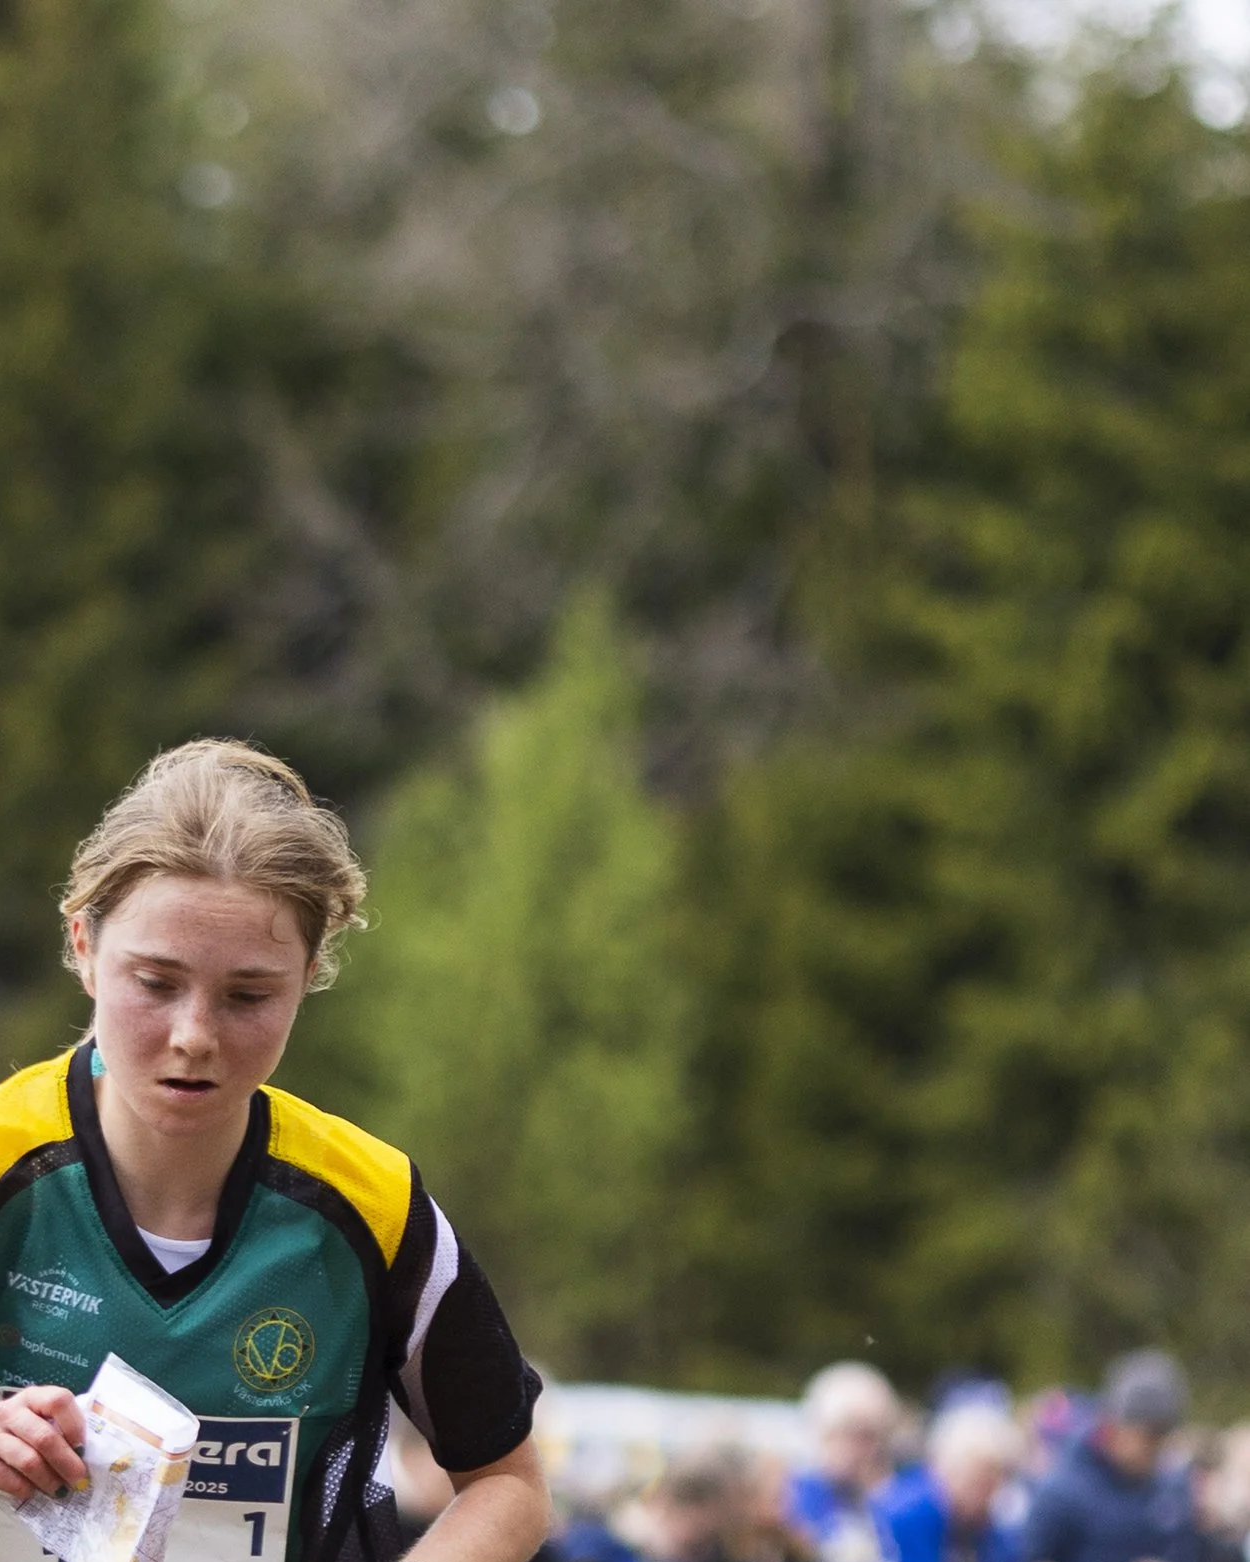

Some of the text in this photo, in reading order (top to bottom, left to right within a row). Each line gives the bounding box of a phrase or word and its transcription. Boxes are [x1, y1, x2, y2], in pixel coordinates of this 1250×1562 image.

[8, 1271, 104, 1315] VÄSTERVIK
[32, 1301, 69, 1320] RESORT
[186, 1481, 228, 1494] 2025
[243, 1511, 266, 1556] 1
